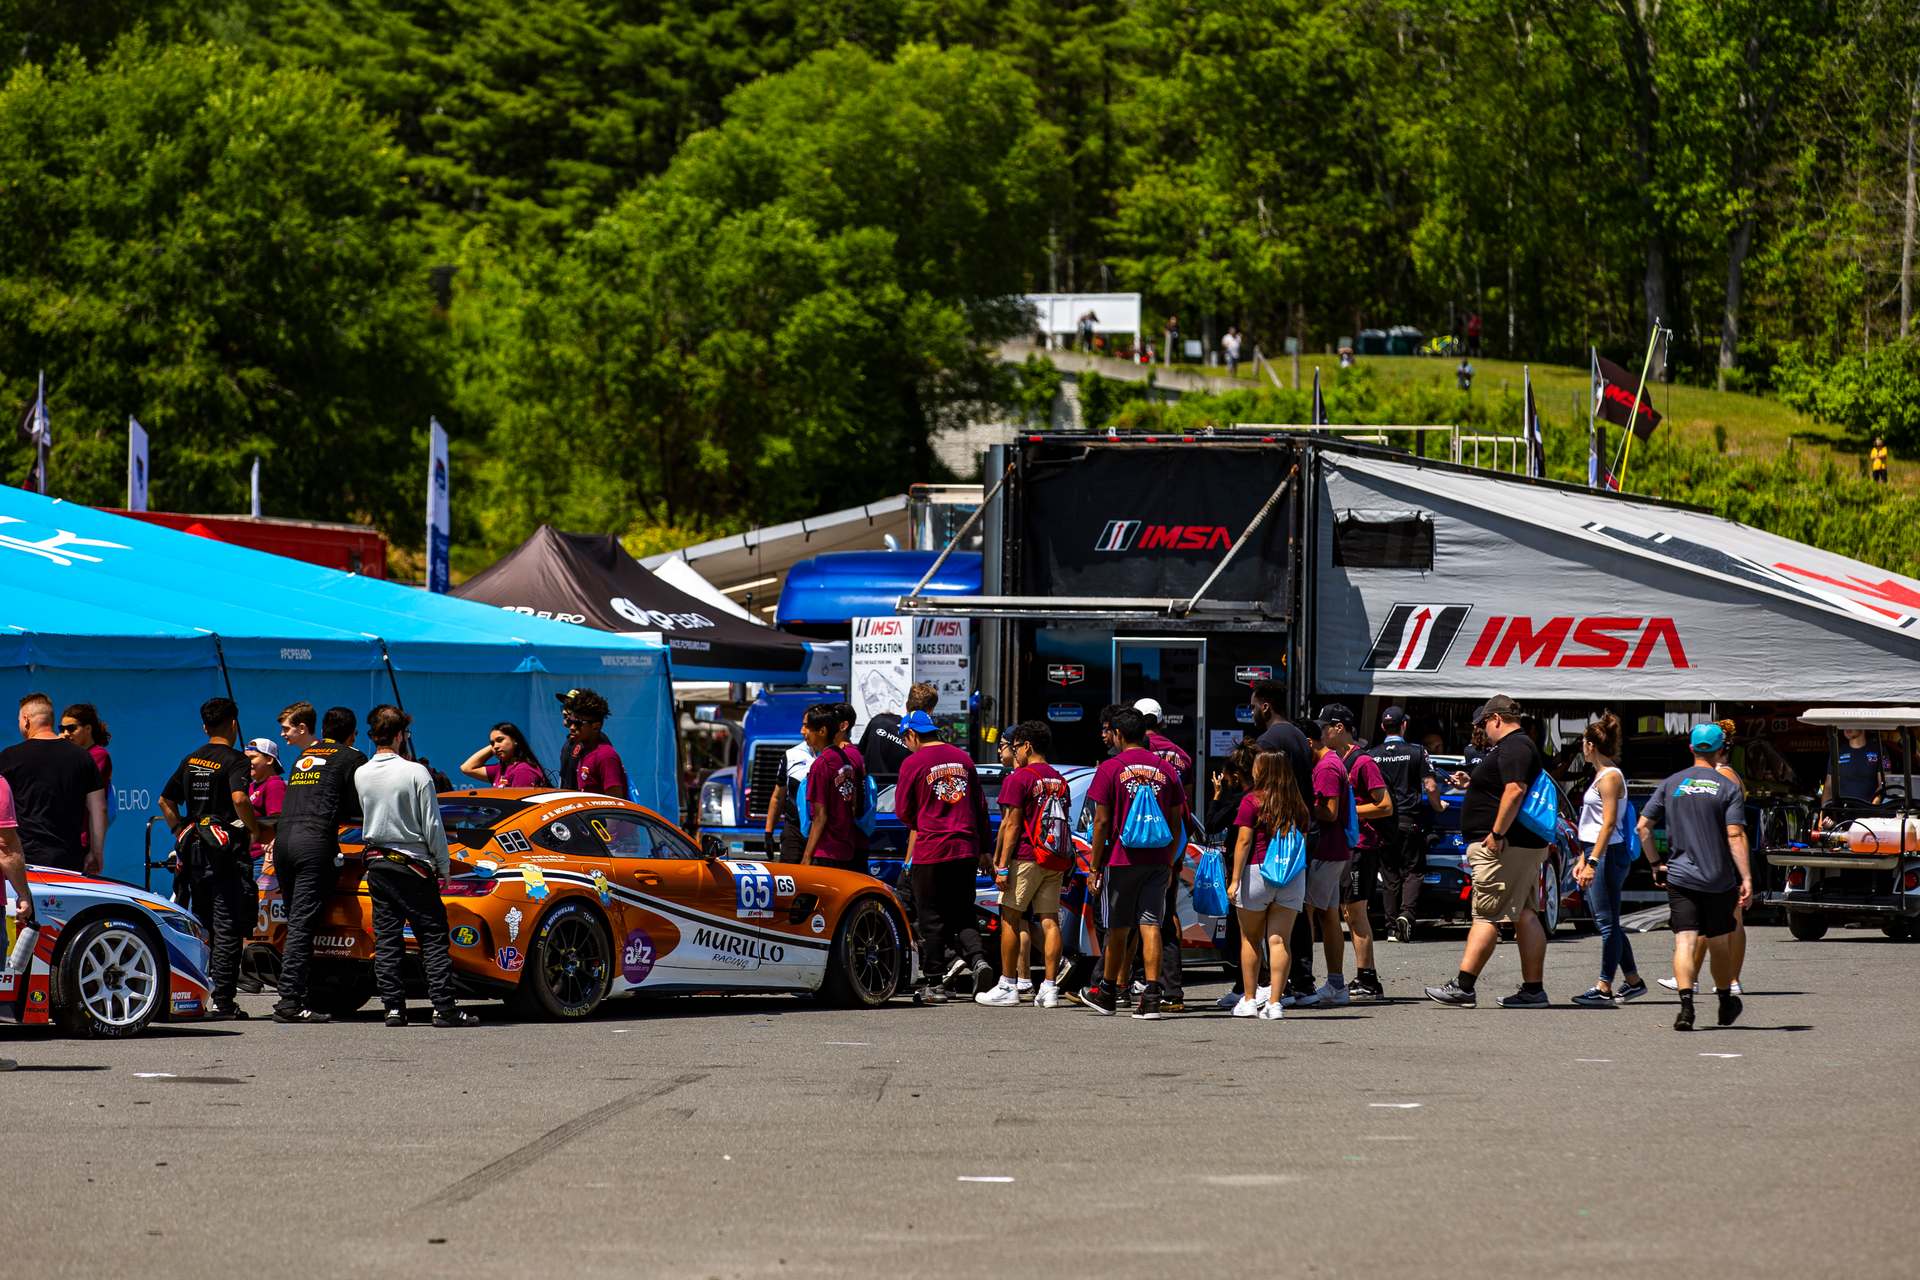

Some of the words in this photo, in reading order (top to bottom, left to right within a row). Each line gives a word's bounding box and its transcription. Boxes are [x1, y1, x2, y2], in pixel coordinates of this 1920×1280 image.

[1138, 526, 1233, 550] IMSA
[871, 621, 903, 636] IMSA
[933, 622, 962, 636] IMSA
[855, 643, 873, 654] RACE
[874, 643, 903, 653] STATION
[917, 643, 936, 655] RACE
[937, 644, 963, 655] STATION
[1464, 616, 1690, 669] IMSA
[1382, 755, 1411, 763] HYUNDAI
[117, 788, 150, 810] EURO
[740, 876, 770, 909] 65
[777, 878, 795, 893] GS
[271, 904, 288, 918] GS
[549, 905, 576, 923] MICHELIN
[313, 936, 355, 948] RILLO
[693, 928, 785, 963] MURILLO
[711, 953, 749, 969] RACING
